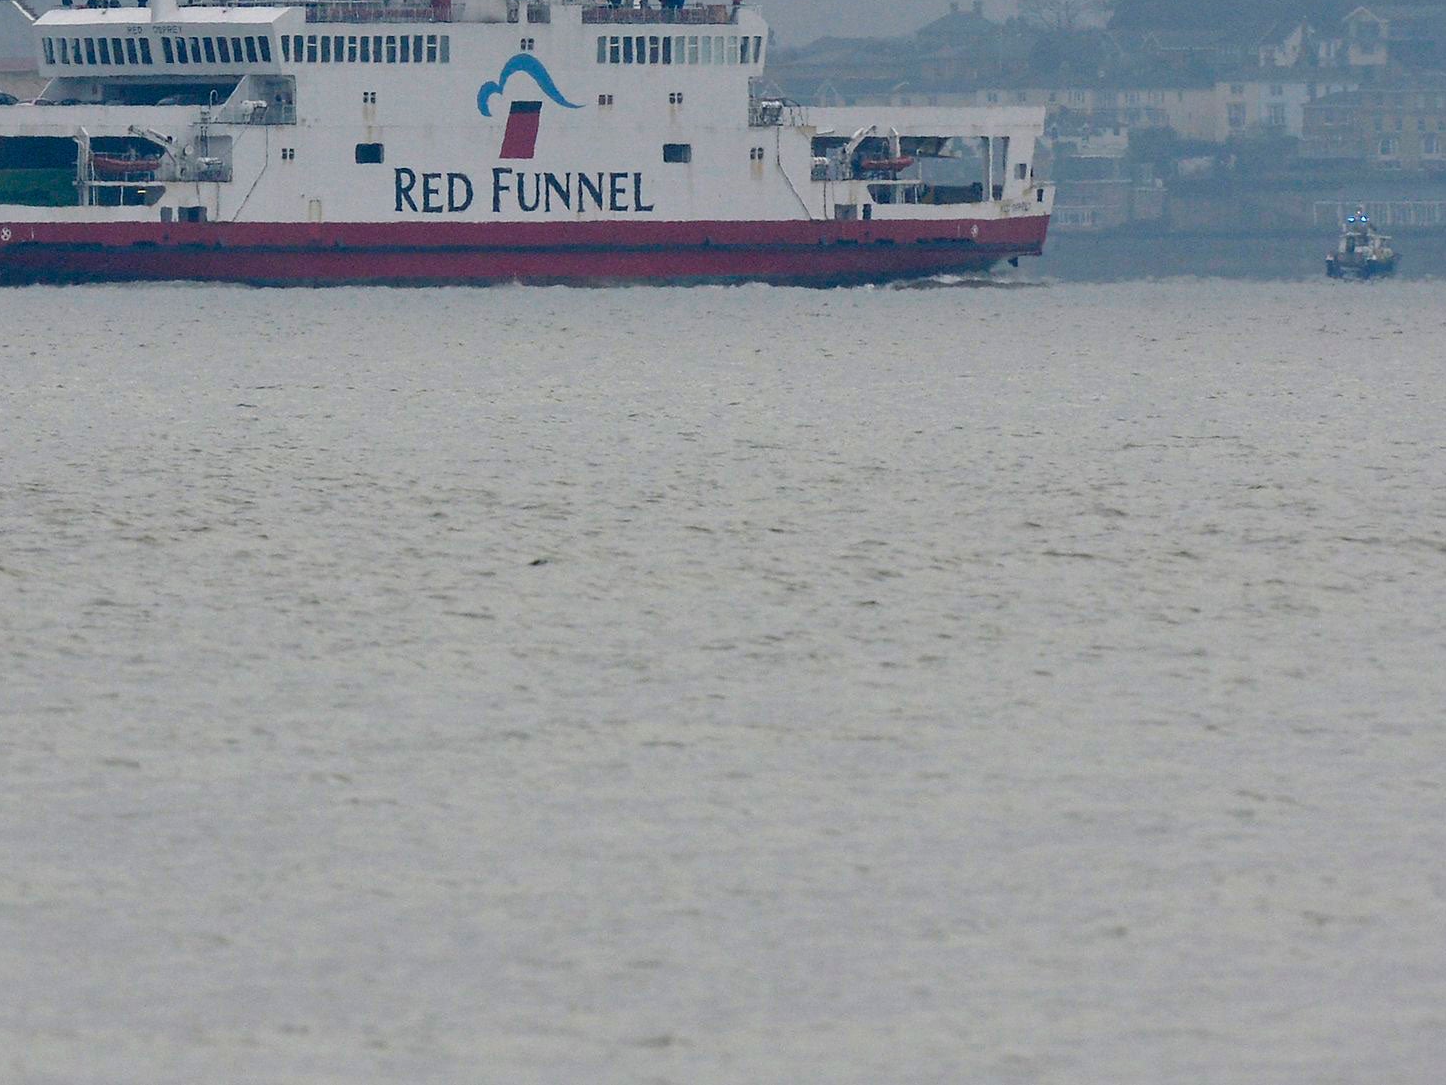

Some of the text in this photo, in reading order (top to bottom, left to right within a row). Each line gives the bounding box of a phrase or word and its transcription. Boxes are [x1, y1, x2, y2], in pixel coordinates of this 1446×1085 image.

[126, 26, 143, 34] RED
[394, 167, 655, 213] RED FUNNEL
